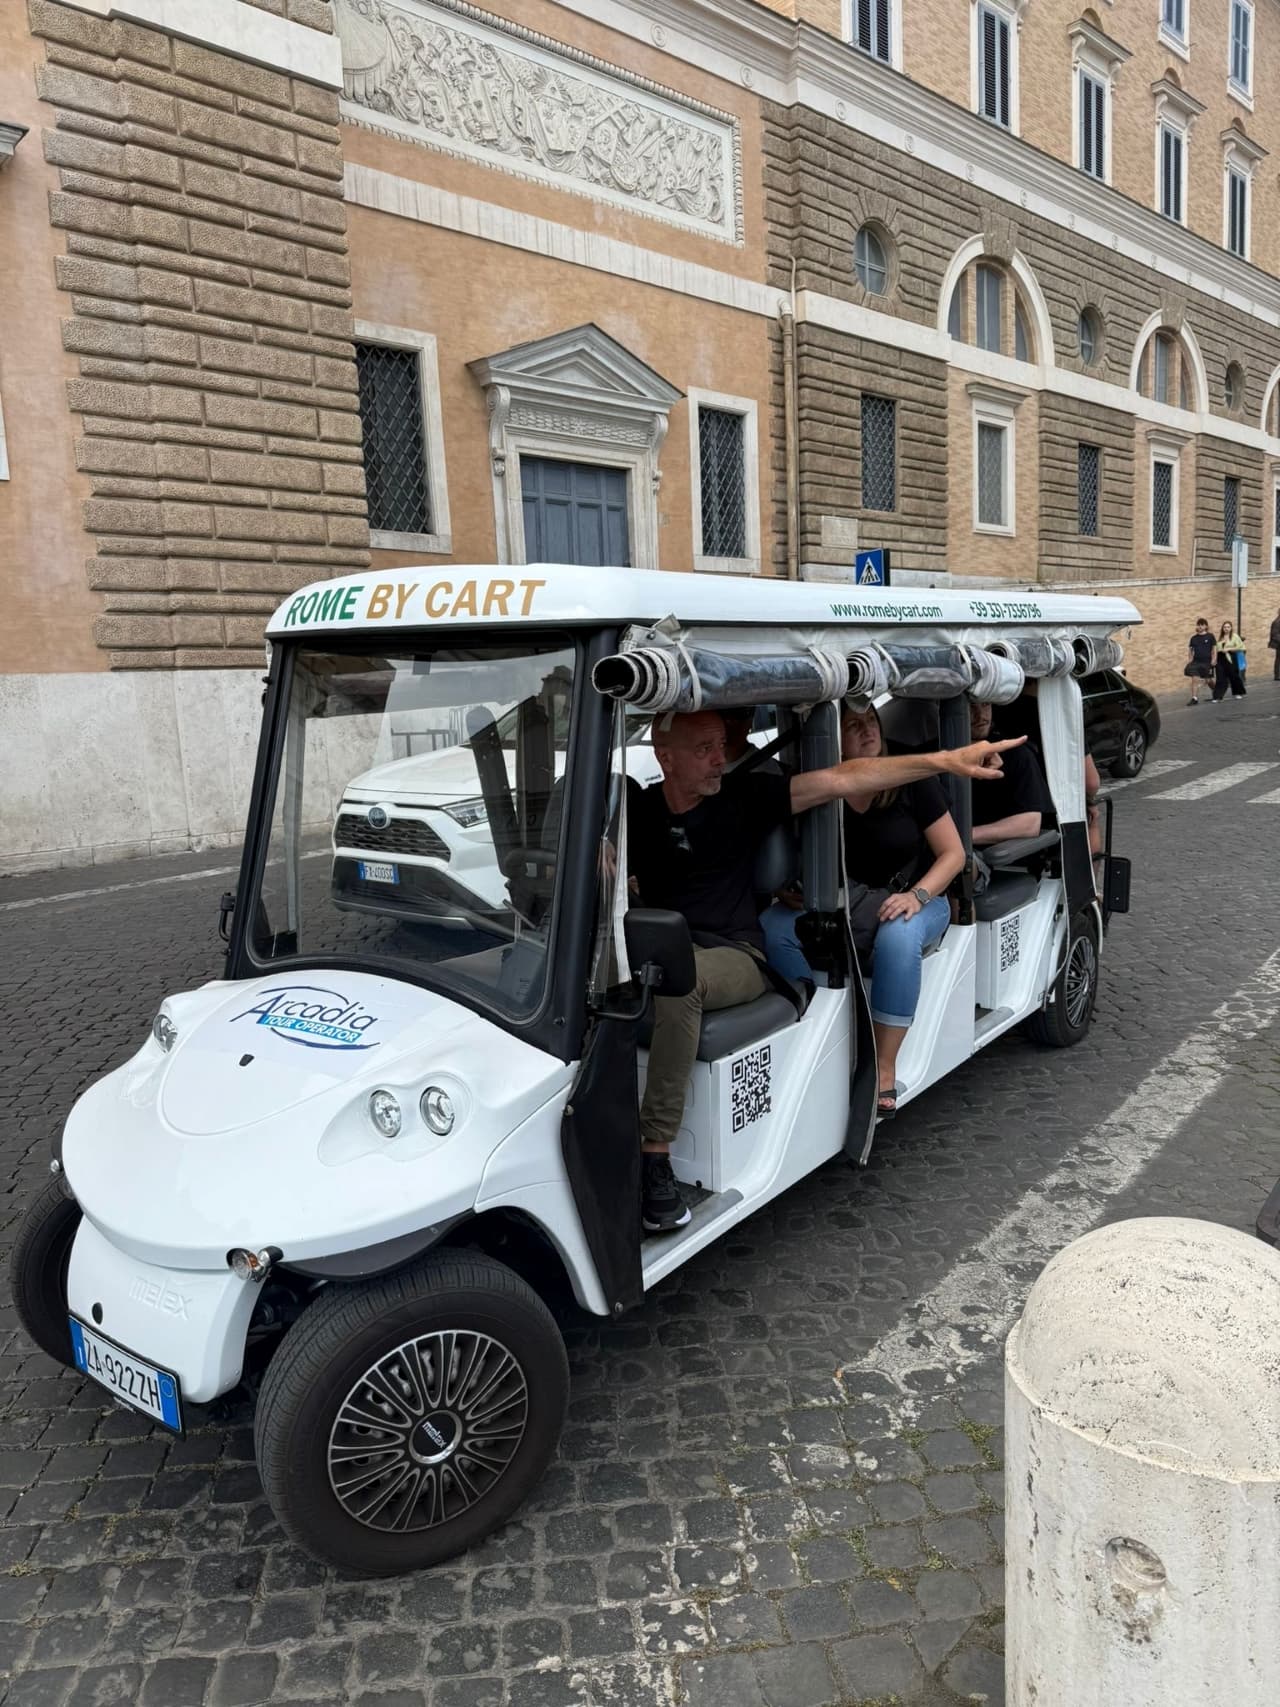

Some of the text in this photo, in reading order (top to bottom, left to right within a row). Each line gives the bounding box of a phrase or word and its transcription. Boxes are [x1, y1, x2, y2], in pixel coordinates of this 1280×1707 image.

[284, 579, 547, 627] ROME BY CART
[830, 602, 943, 621] www.romebycart.com
[969, 601, 987, 617] +39
[229, 992, 378, 1031] Arcadia
[265, 1016, 358, 1042] TOUR OPERATOR
